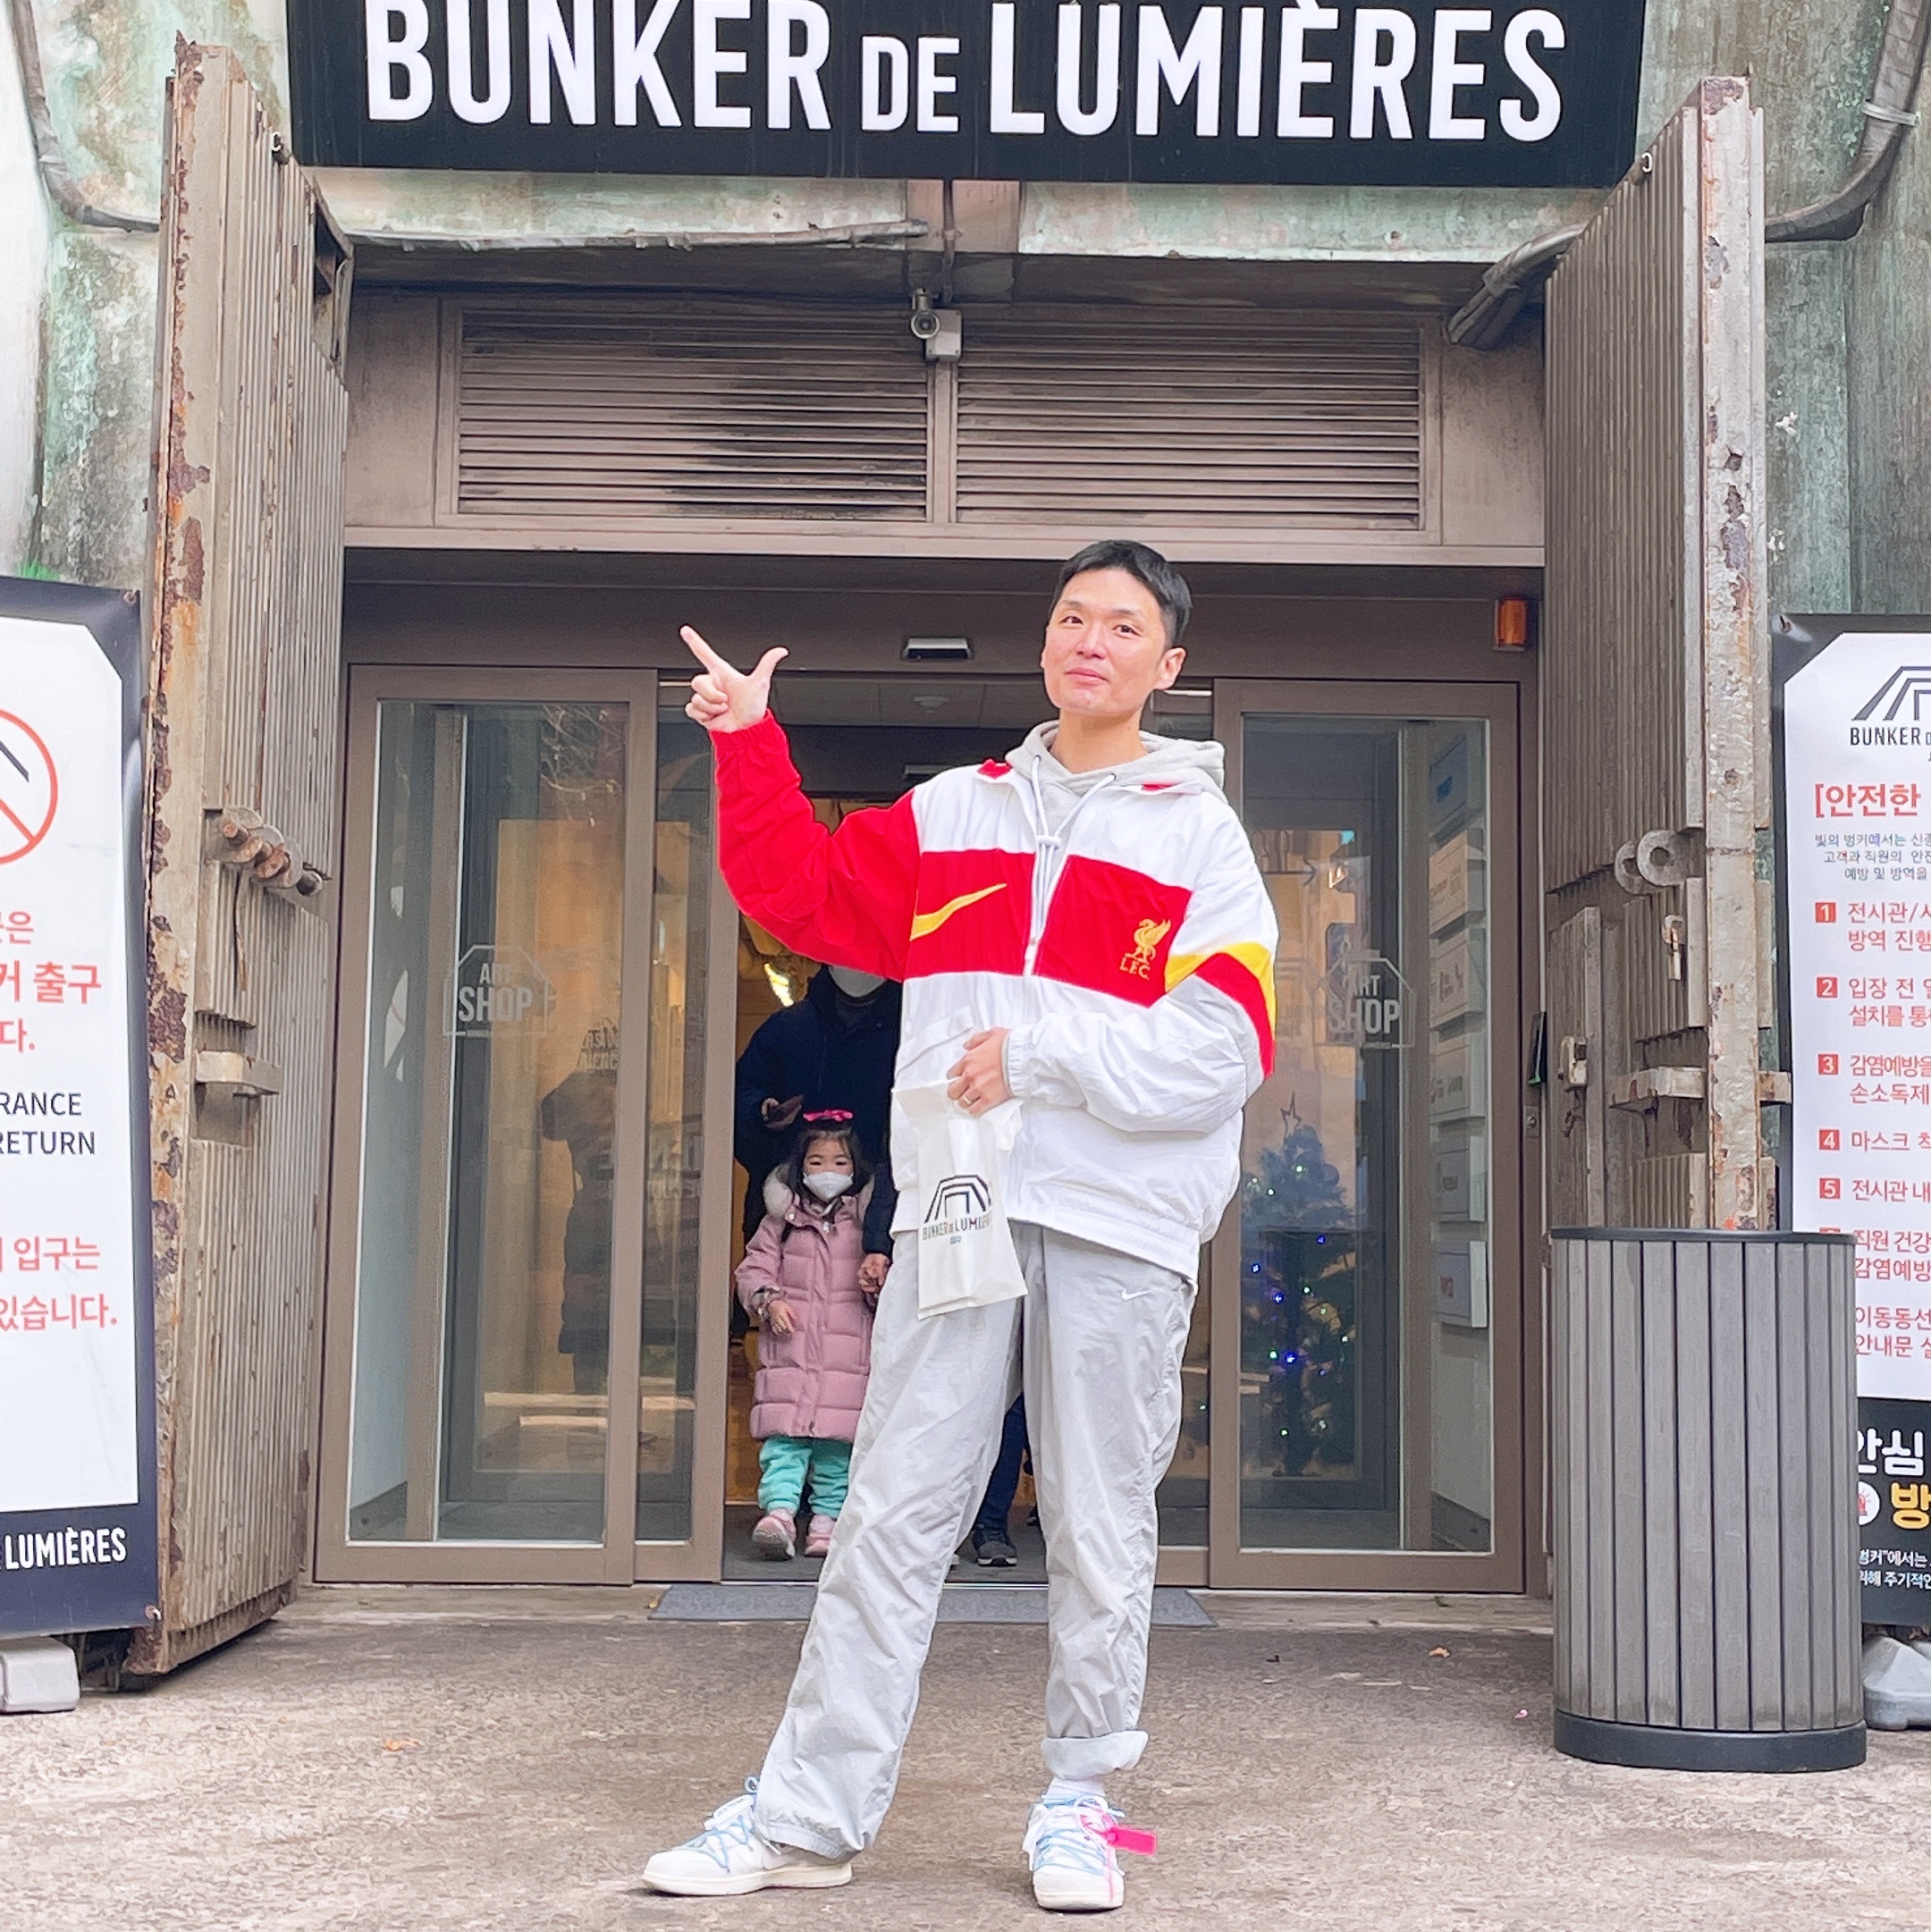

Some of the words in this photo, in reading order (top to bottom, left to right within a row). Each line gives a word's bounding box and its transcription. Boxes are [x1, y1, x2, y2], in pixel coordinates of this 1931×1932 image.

[366, 0, 831, 129] BUNKER
[861, 36, 961, 132] DE
[990, 0, 1566, 141] LUMIÈRES
[1850, 727, 1921, 746] BUNKER
[1815, 783, 1921, 818] [안전한
[1843, 833, 1906, 848] 벙커에서는
[1824, 850, 1860, 864] 고객과
[1844, 867, 1869, 881] 예방
[1818, 903, 1832, 922] 1
[0, 911, 34, 945] 은
[1849, 930, 1886, 951] 방역
[33, 961, 102, 1004] 출구
[1820, 979, 1834, 997] 2
[1849, 977, 1887, 1000] 입장
[1896, 978, 1914, 1000] 전
[459, 986, 533, 1021] SHOP
[1328, 998, 1401, 1033] SHOP
[1849, 1006, 1904, 1026] 설치를
[1909, 1006, 1931, 1027] 통
[1821, 1055, 1835, 1074] 3
[1851, 1083, 1929, 1105] 손소독제
[1822, 1130, 1836, 1149] 4
[1851, 1131, 1910, 1152] 마스크
[1822, 1179, 1837, 1198] 5
[1852, 1180, 1908, 1202] 전시관
[1912, 1182, 1931, 1202] 내
[14, 1236, 100, 1270] 입구는
[4, 1526, 127, 1570] LUMIÈRES
